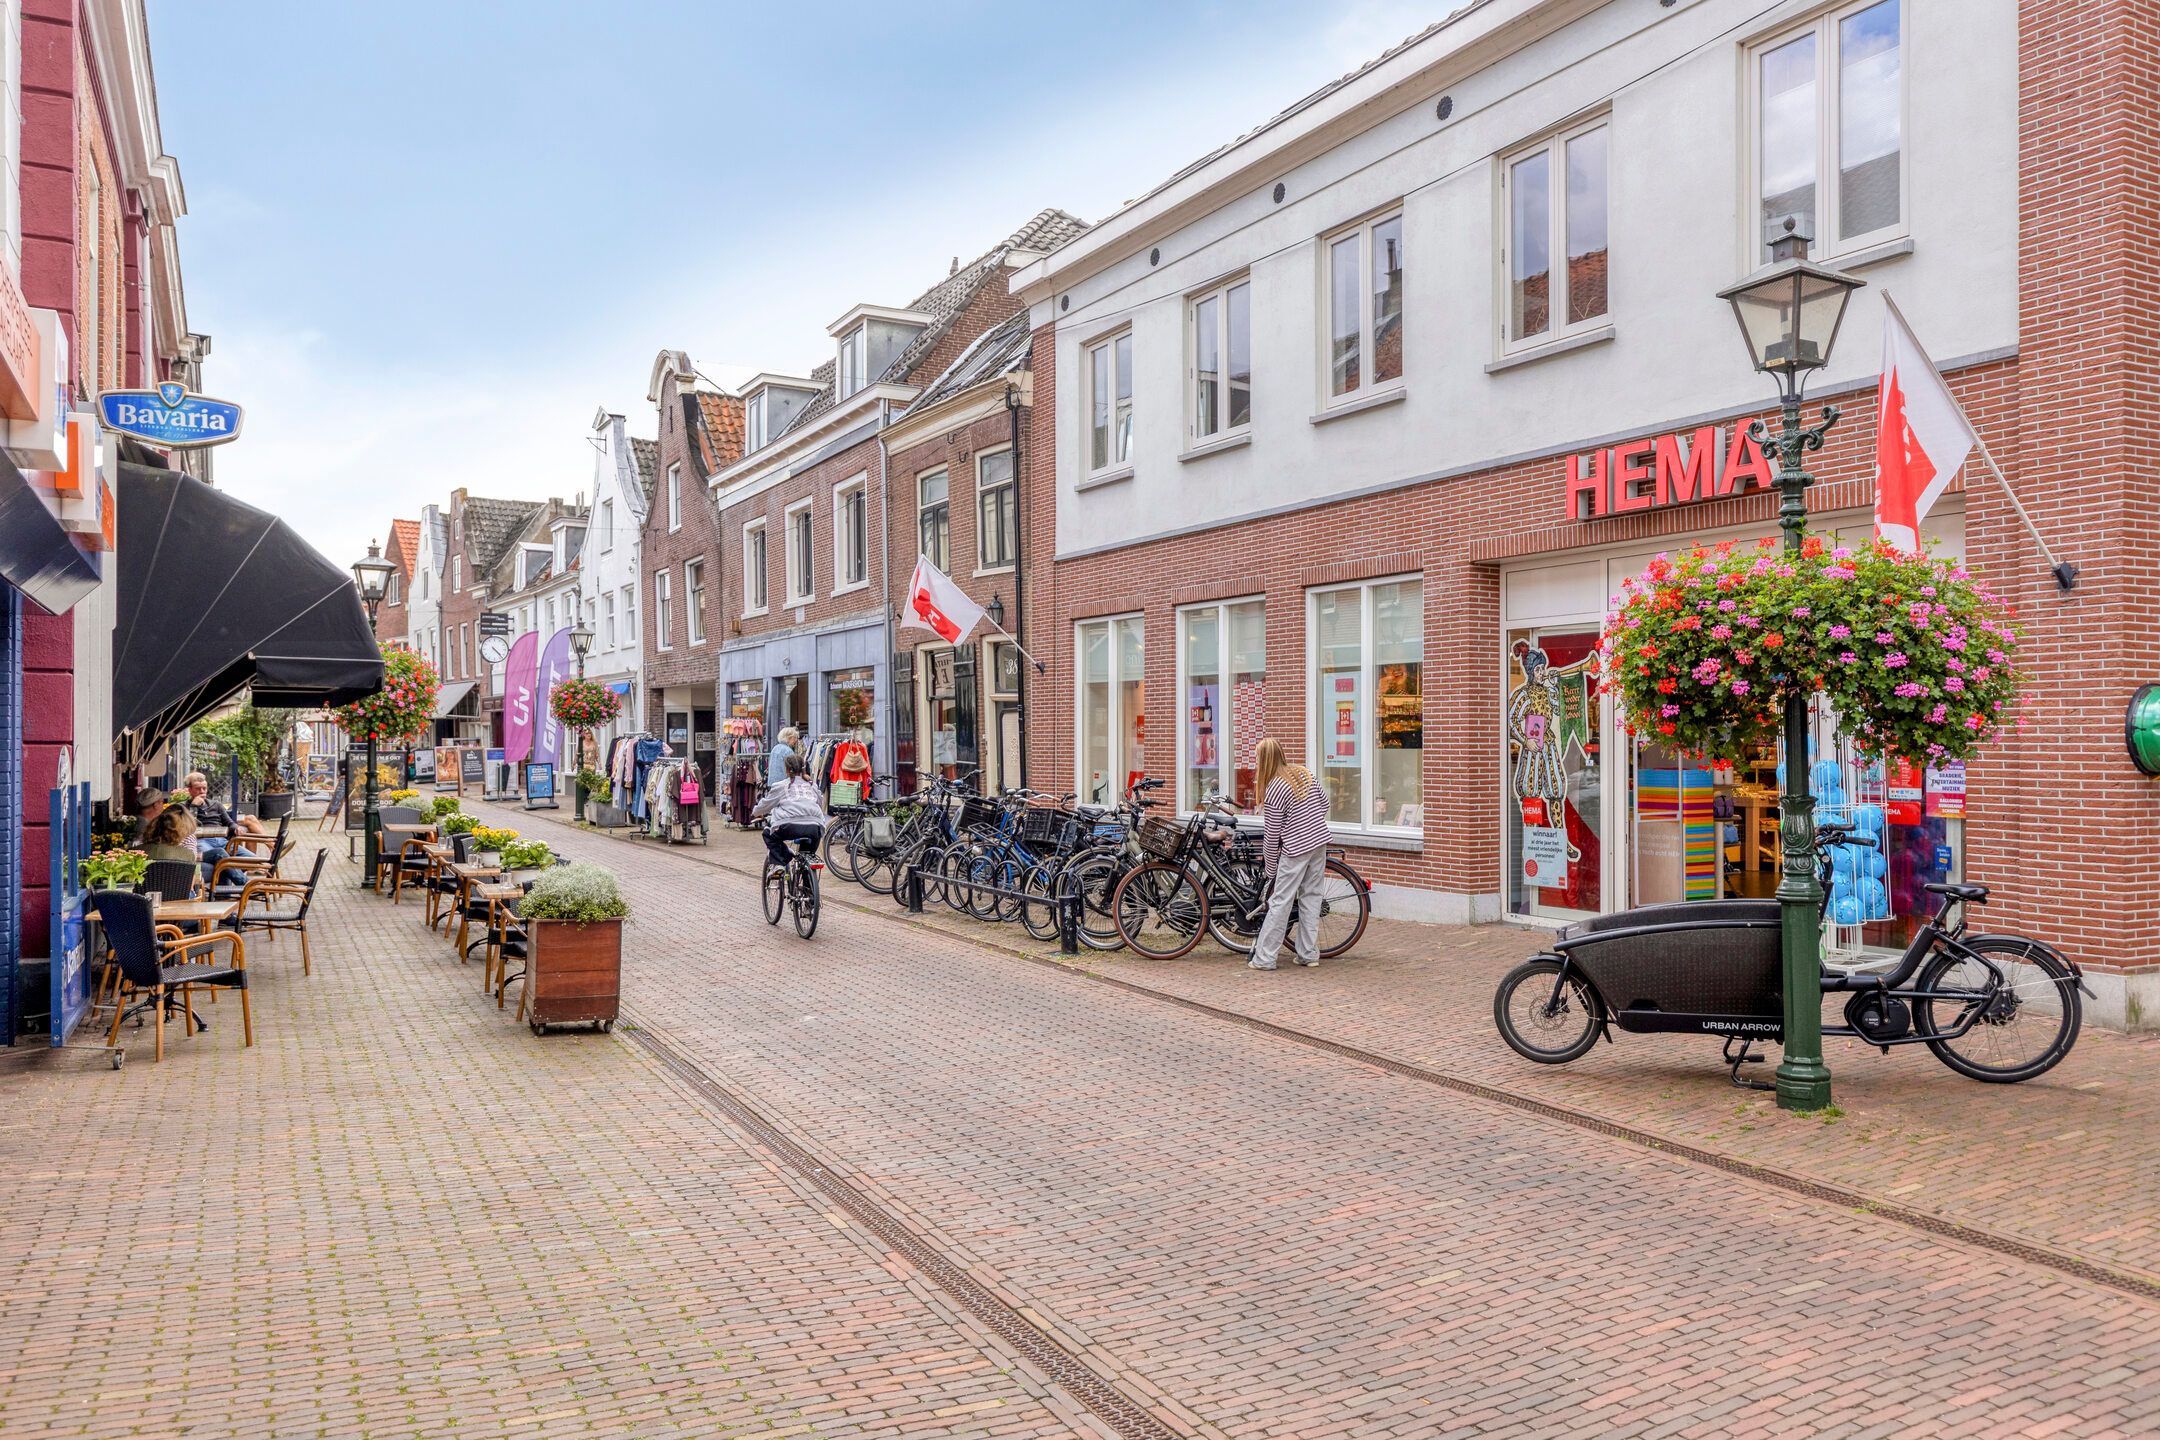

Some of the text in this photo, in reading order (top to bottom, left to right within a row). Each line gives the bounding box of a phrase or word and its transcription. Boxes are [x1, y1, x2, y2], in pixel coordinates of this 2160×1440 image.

[117, 403, 227, 431] Bavaria
[1566, 418, 1776, 520] HEMA
[1524, 807, 1542, 815] HEMA
[1532, 830, 1558, 838] winnaar!
[1702, 1021, 1781, 1031] URBAN ARROW
